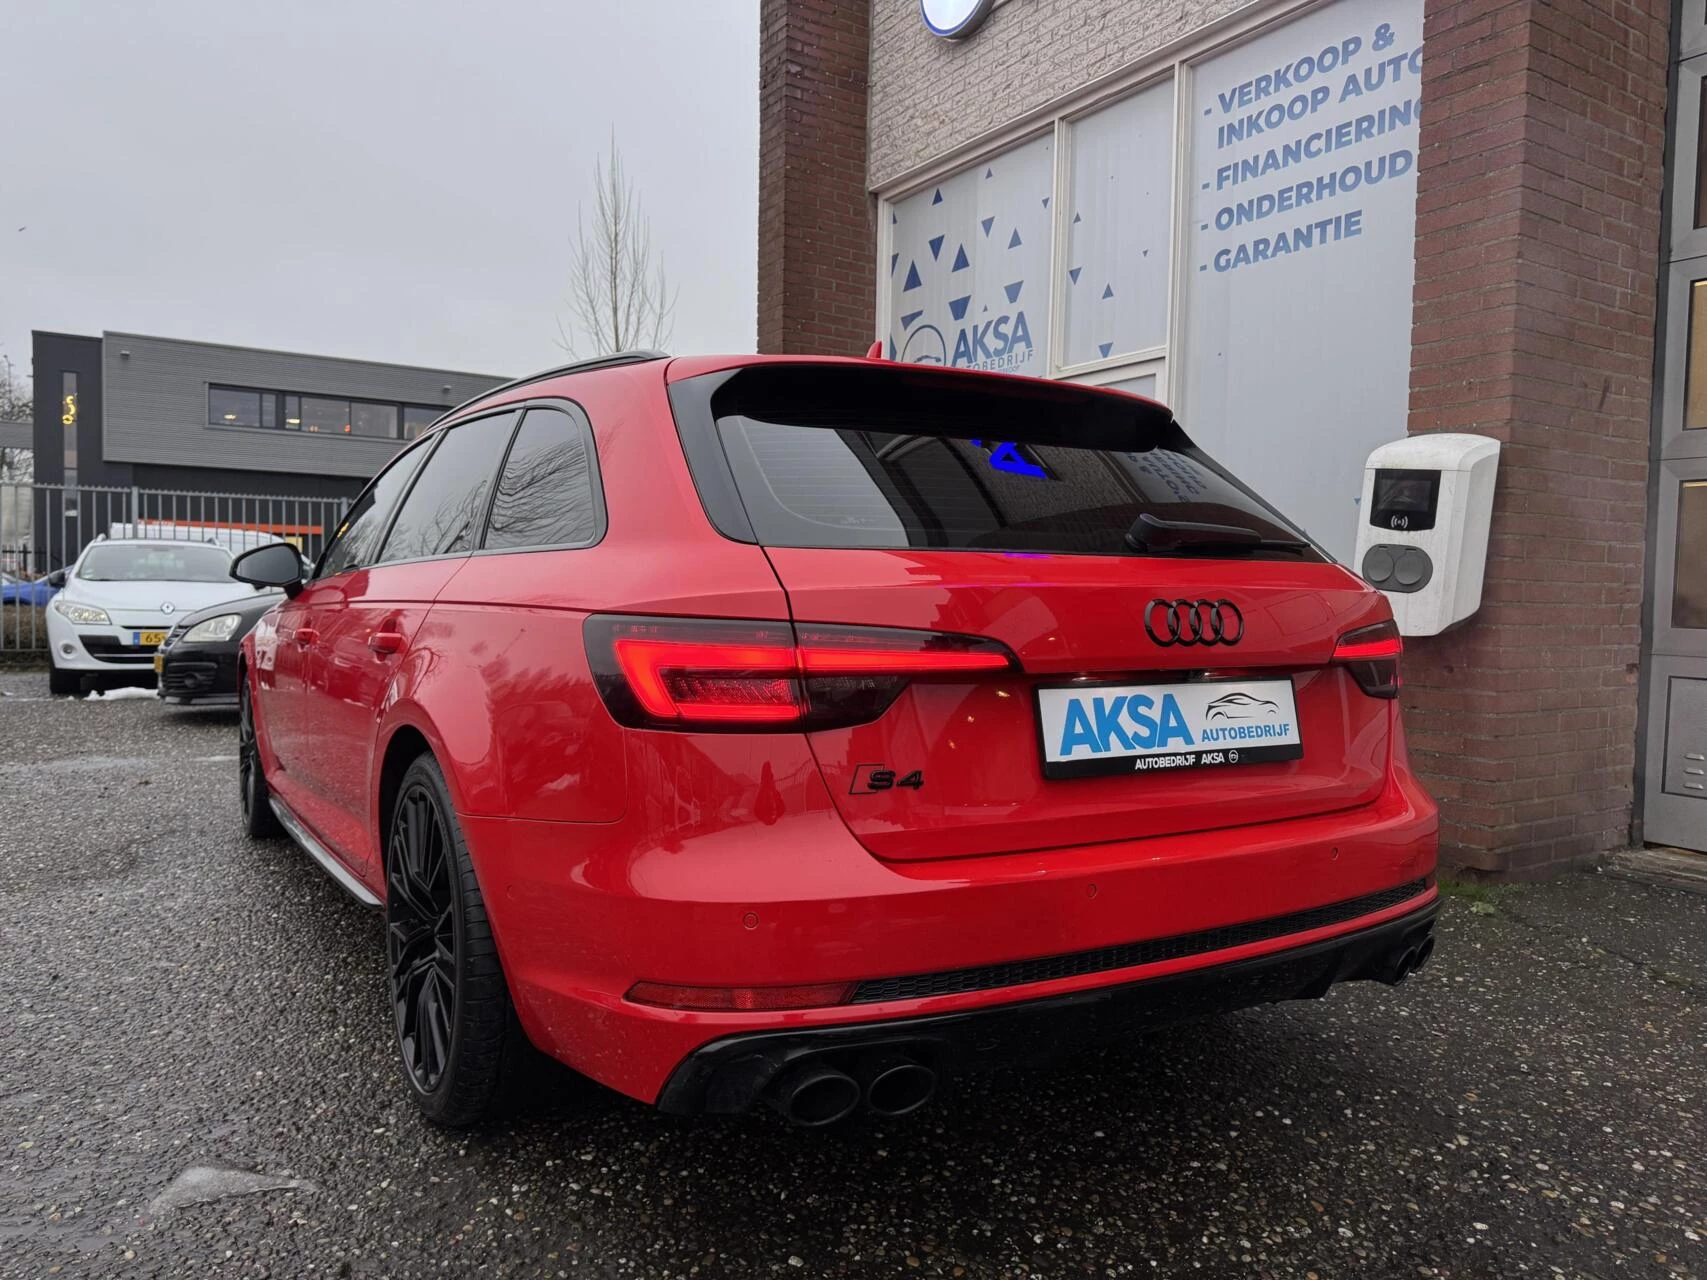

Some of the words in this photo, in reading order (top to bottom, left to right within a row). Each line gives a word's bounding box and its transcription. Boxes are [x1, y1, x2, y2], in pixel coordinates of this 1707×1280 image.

[1218, 36, 1362, 114] VERKOOP
[1372, 23, 1395, 51] &
[1218, 86, 1330, 149] INKOOP
[1215, 149, 1413, 231] ONDERHOUD
[1214, 209, 1362, 273] GARANTIE
[952, 311, 1033, 367] AKSA
[965, 349, 1033, 371] OBEDRIJF
[1060, 693, 1195, 756] AKSA
[1202, 724, 1290, 742] AUTOBEDRIJF
[867, 769, 924, 790] S4
[1135, 755, 1196, 770] AUTOBEDRIJF
[1201, 752, 1225, 765] AKSA
